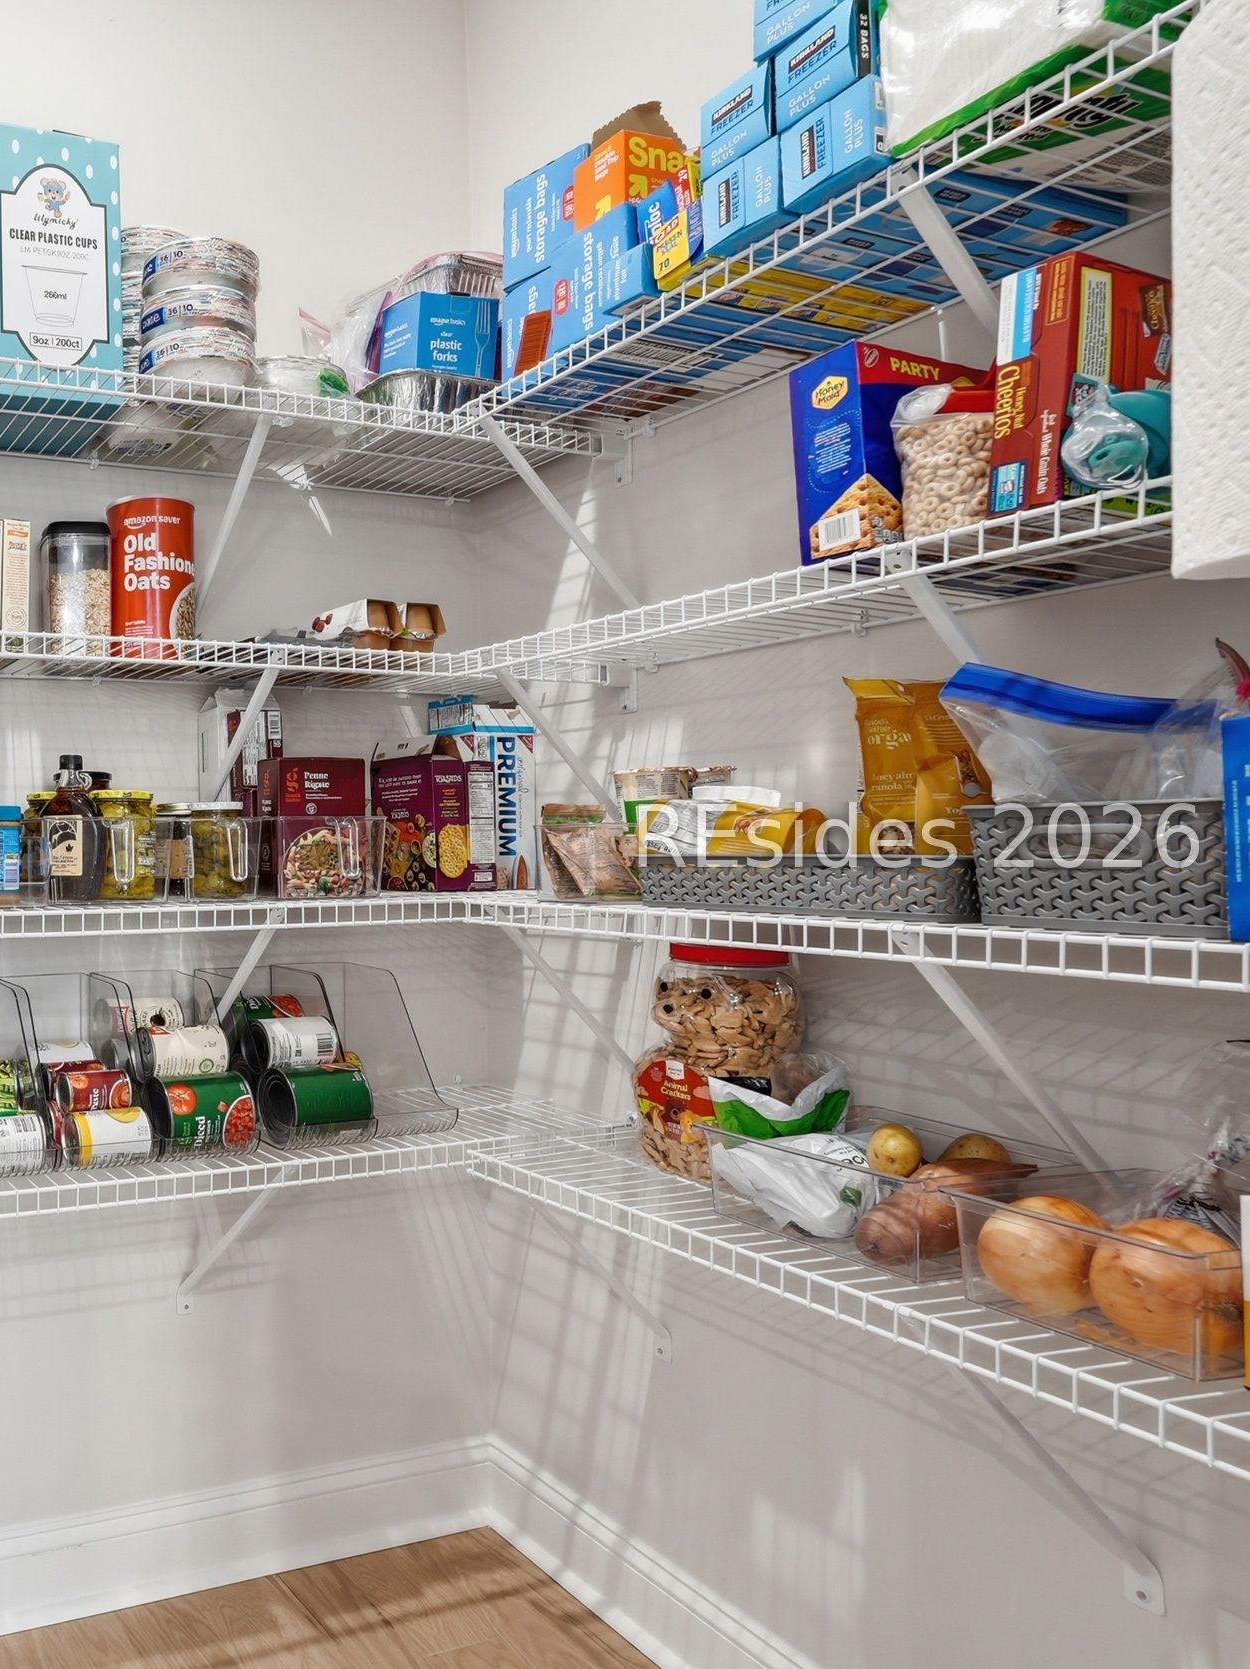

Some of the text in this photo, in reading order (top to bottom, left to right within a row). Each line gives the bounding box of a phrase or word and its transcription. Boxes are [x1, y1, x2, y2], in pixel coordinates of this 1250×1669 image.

[767, 3, 810, 35] GALLON
[767, 22, 795, 44] PLUS
[859, 13, 869, 59] 32 BAGS
[788, 40, 837, 83] FREEZER
[789, 74, 831, 108] GALLON
[790, 95, 816, 117] PLUS
[710, 101, 754, 135] FREEZER
[844, 109, 853, 154] GALLON
[854, 118, 863, 148] PLUS
[711, 130, 748, 160] GALLON
[816, 117, 825, 169] FREEZER
[711, 149, 735, 167] PLUS
[731, 170, 739, 219] FREEZER
[755, 166, 764, 208] GALLON
[765, 175, 773, 204] PLUS
[534, 174, 548, 263] storage bags
[9, 228, 98, 250] CLEAR PLASTIC CUPS
[173, 250, 184, 259] 10
[658, 258, 670, 272] 70
[582, 231, 596, 331] storage bags
[43, 290, 68, 301] 266ml
[527, 285, 539, 315] ags
[183, 303, 194, 313] 10
[32, 335, 81, 349] 9oz 200ct
[169, 342, 180, 352] 10
[430, 340, 463, 351] plastic
[432, 350, 458, 362] forks
[889, 357, 940, 380] PARTY
[815, 380, 846, 398] Honey
[994, 365, 1020, 440] Cheerios
[123, 515, 181, 529] amazon saver
[123, 532, 158, 554] Old
[123, 573, 171, 592] Oats
[304, 771, 329, 780] Penne
[304, 780, 330, 790] Rigate
[496, 736, 517, 857] PREMIUM
[660, 1086, 692, 1100] Crackers
[663, 1080, 688, 1092] Animal
[194, 1115, 207, 1148] Diced
